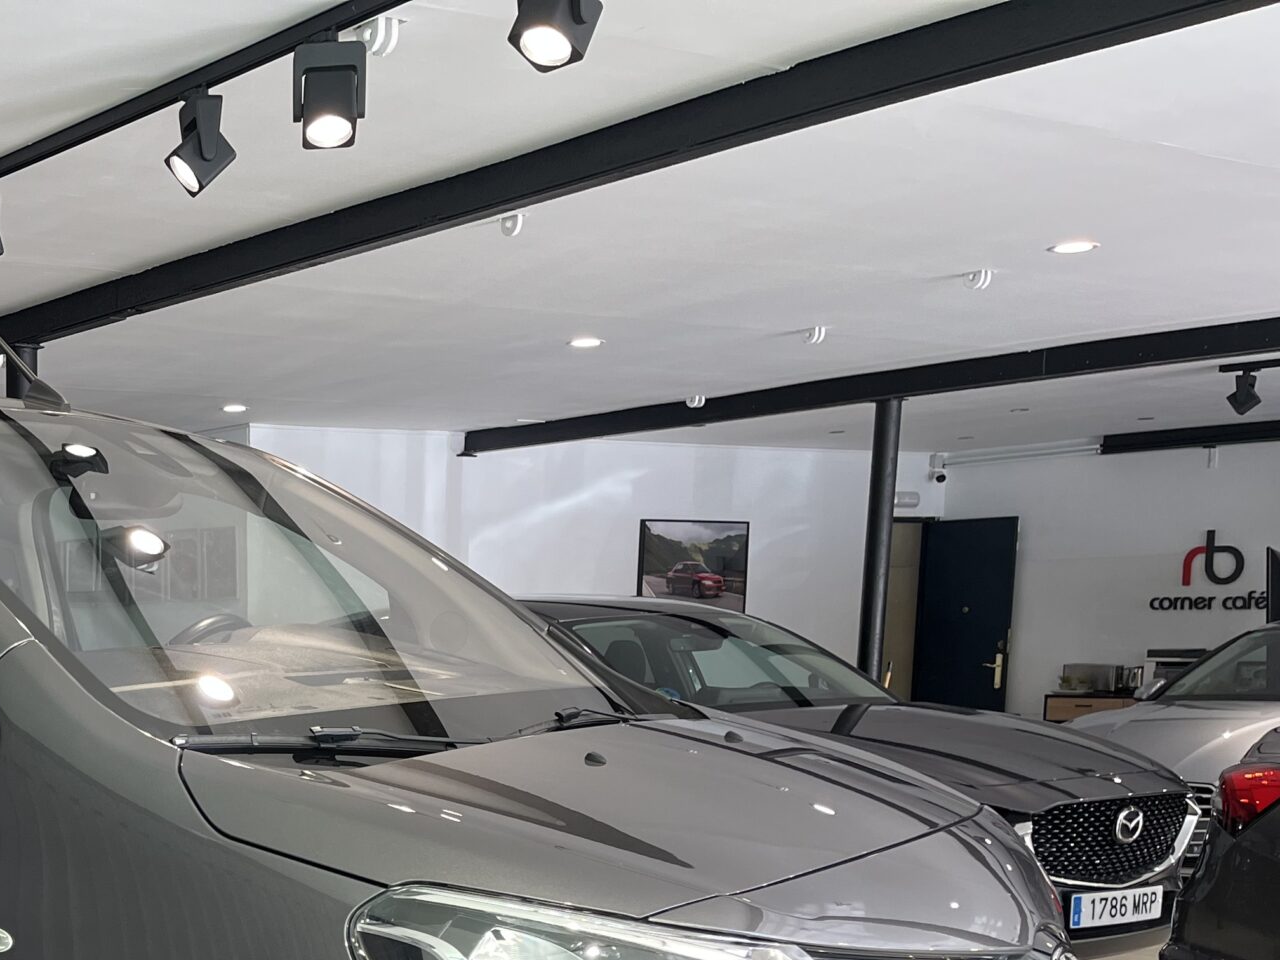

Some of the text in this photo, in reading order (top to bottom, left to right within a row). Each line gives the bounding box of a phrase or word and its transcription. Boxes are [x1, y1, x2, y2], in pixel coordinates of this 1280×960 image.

[1182, 530, 1245, 587] rb
[1149, 590, 1267, 611] corner café
[1090, 891, 1158, 921] 1786 MRP
